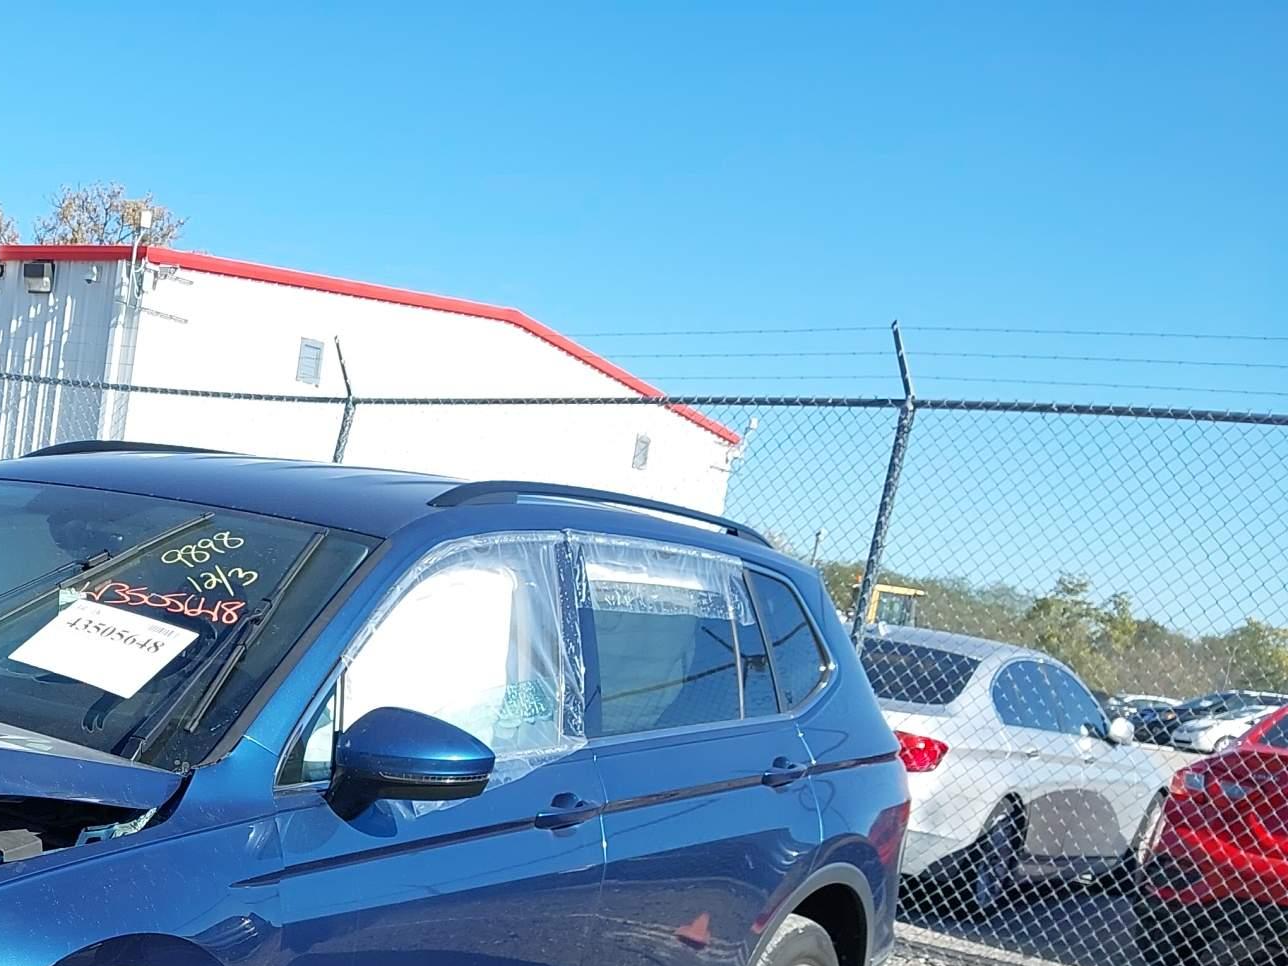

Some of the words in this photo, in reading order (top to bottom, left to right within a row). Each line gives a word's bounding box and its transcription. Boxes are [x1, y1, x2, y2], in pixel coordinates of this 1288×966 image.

[161, 531, 244, 568] 9898
[187, 564, 259, 597] 12/3
[66, 616, 165, 654] 43505648
